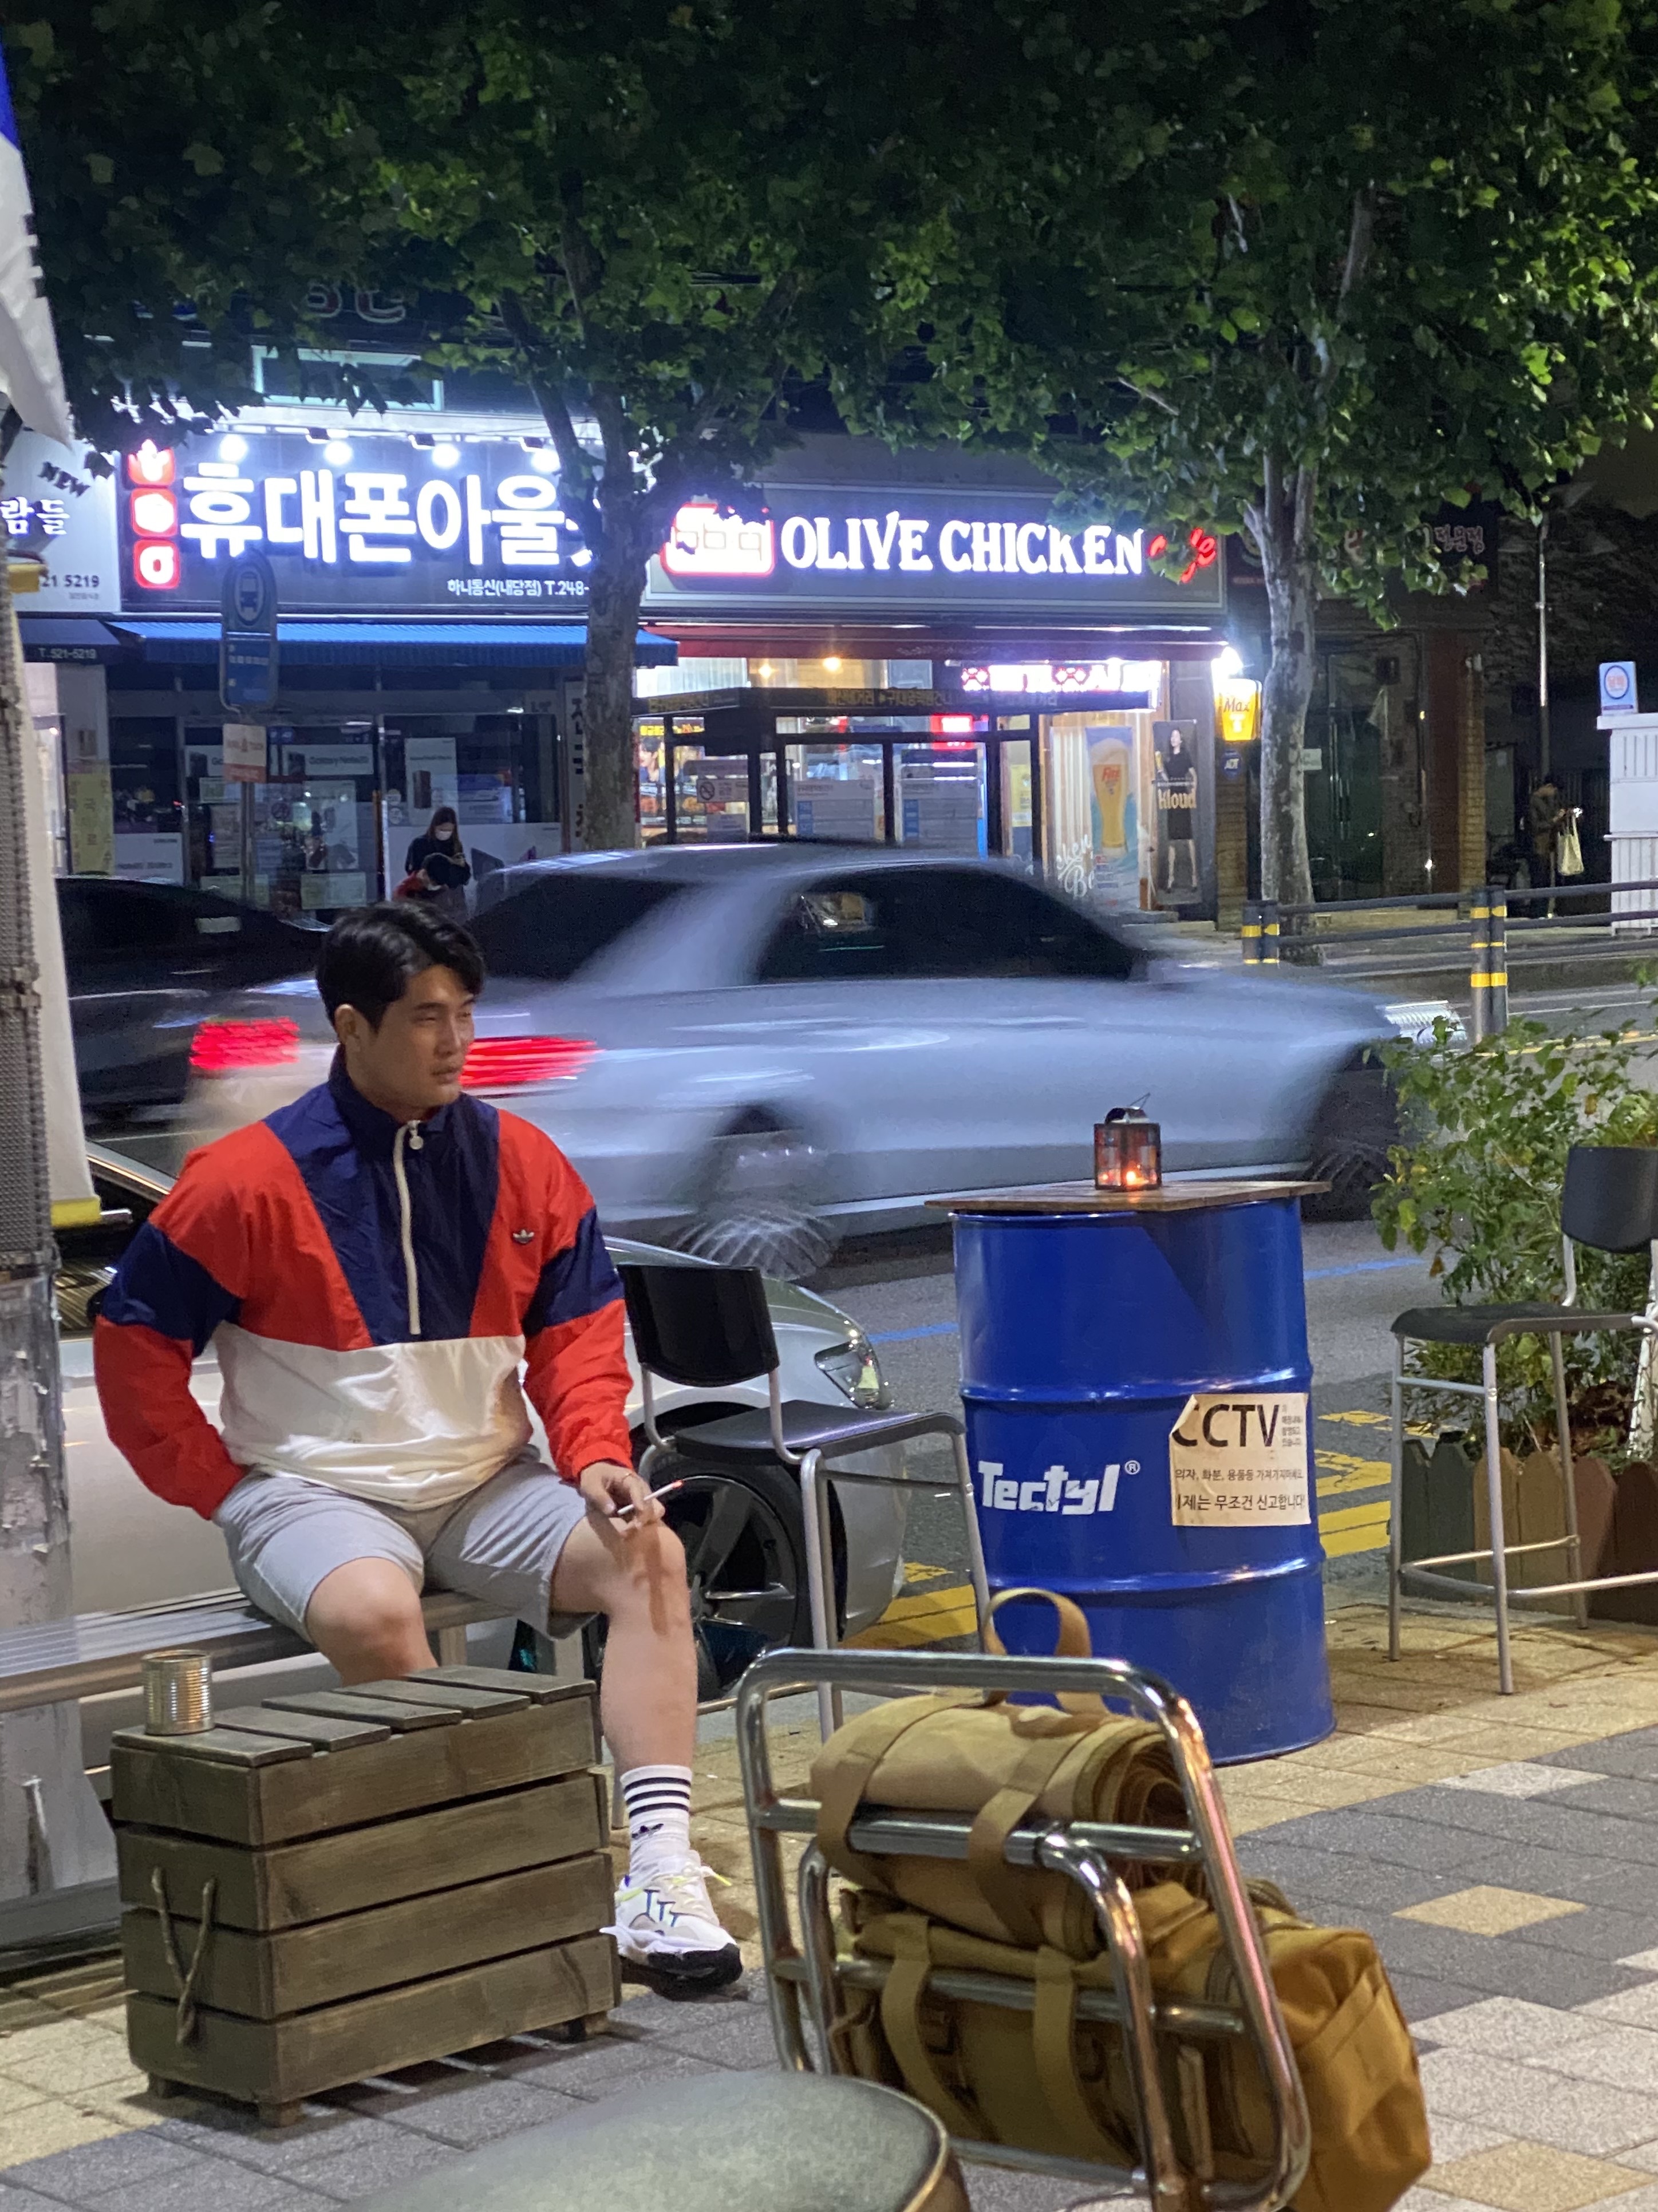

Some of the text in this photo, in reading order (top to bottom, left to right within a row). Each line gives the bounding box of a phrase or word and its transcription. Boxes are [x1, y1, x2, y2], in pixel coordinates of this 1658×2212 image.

[37, 461, 91, 498] NEW
[780, 511, 1144, 575] OLIVE CHICKEN
[64, 575, 100, 588] 5219
[978, 1460, 1120, 1515] Tectyl
[1215, 1495, 1253, 1511] 무조건
